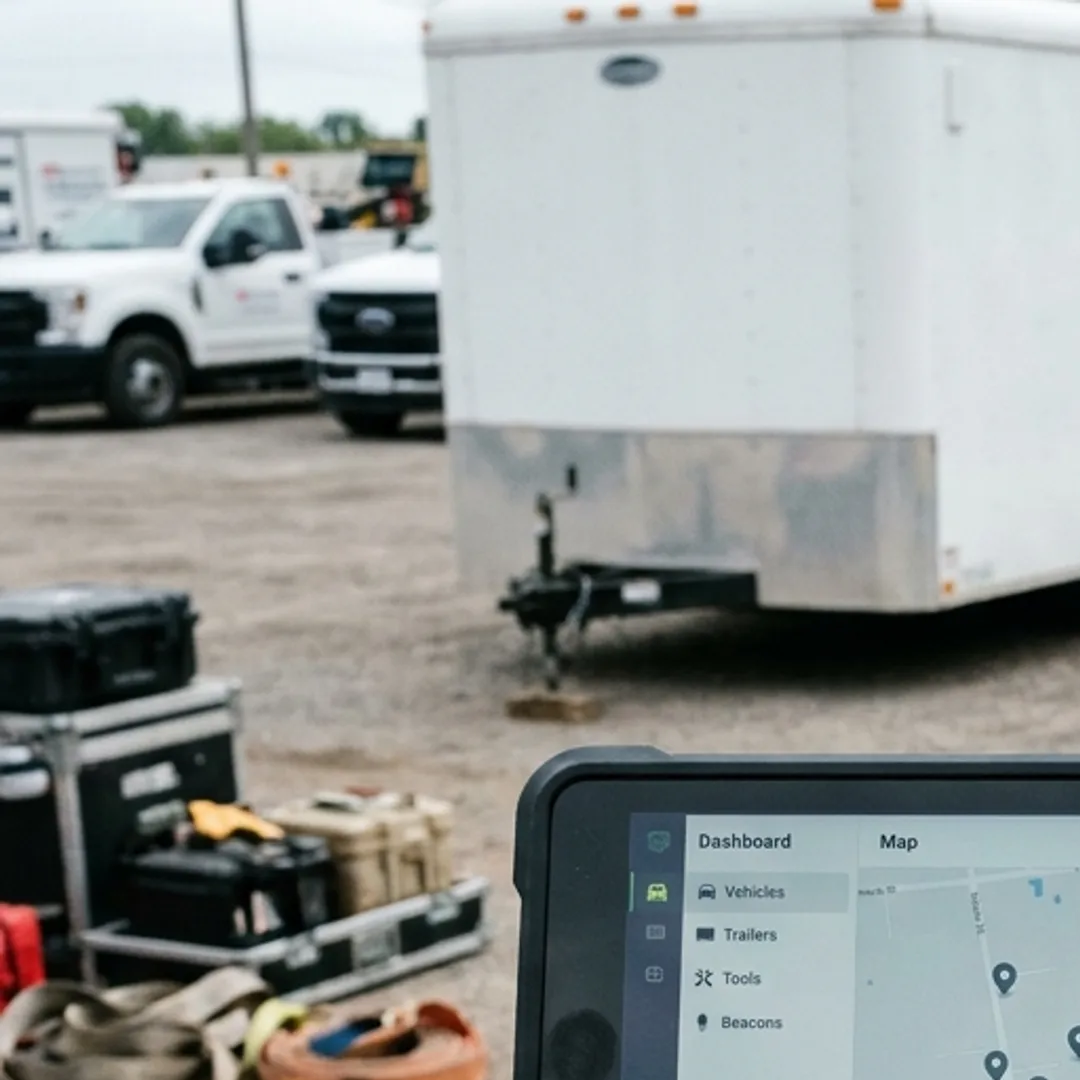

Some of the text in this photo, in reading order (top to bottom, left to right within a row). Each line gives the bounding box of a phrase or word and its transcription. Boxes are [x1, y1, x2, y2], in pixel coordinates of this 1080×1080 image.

[698, 833, 792, 850] Dashboard
[879, 834, 919, 852] Map
[724, 884, 785, 899] Vehicles
[723, 928, 778, 942] Trailers
[723, 971, 762, 986] Tools
[720, 1015, 784, 1030] Beacons
